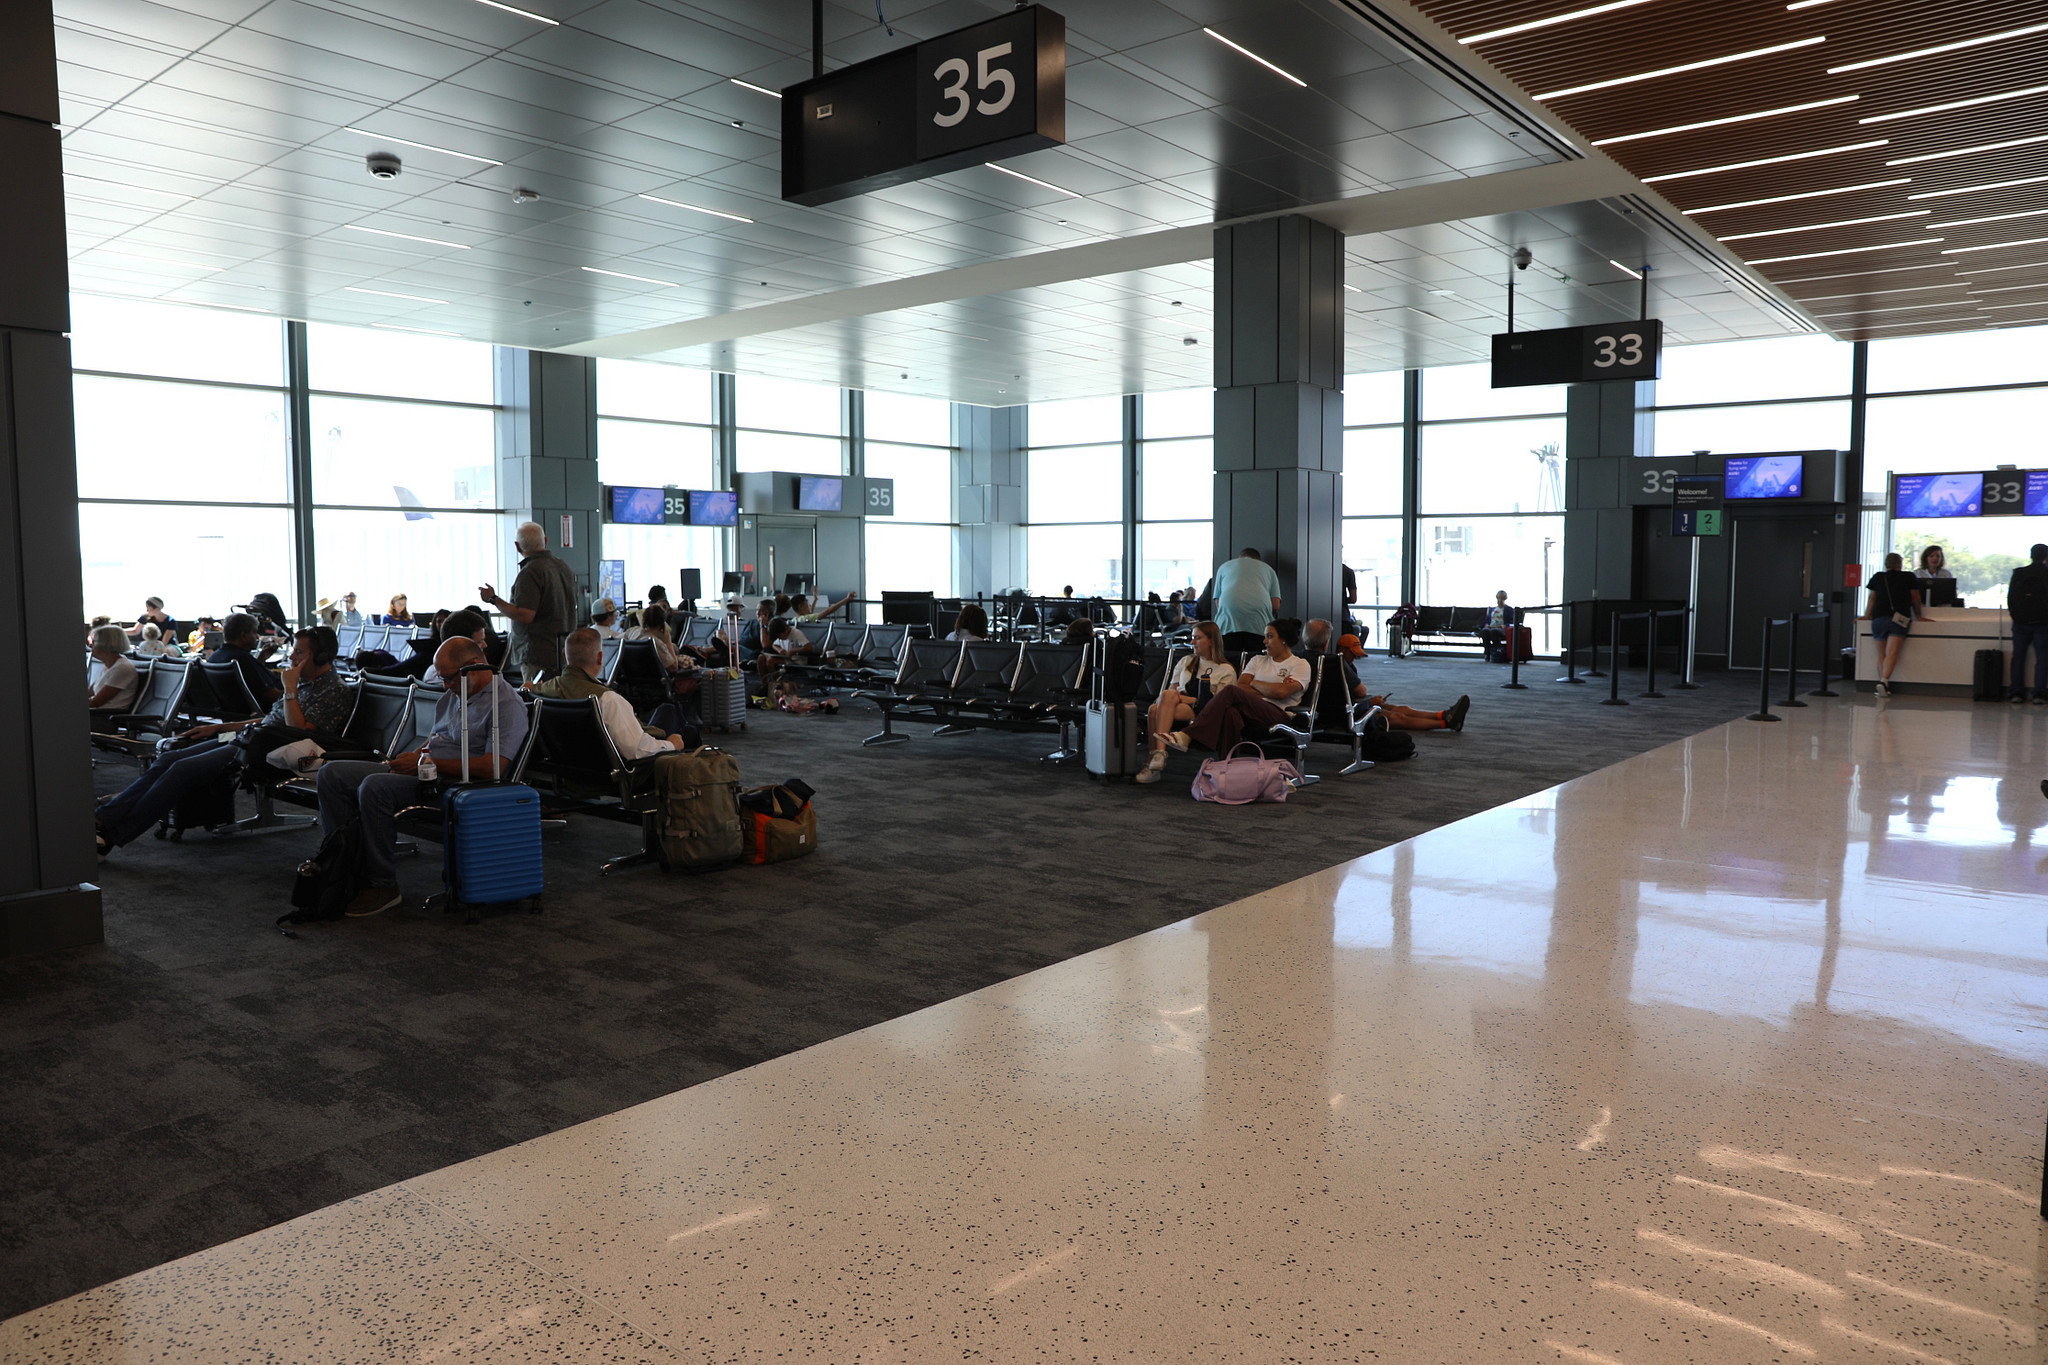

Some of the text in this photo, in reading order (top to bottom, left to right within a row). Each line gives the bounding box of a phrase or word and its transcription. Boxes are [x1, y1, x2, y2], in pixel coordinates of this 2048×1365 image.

[933, 41, 1016, 128] 35
[1593, 333, 1643, 368] 33
[1642, 470, 1678, 494] 33
[1983, 482, 2021, 503] 33
[664, 497, 685, 515] 35
[869, 487, 891, 507] 35
[1682, 513, 1713, 524] 1 2
